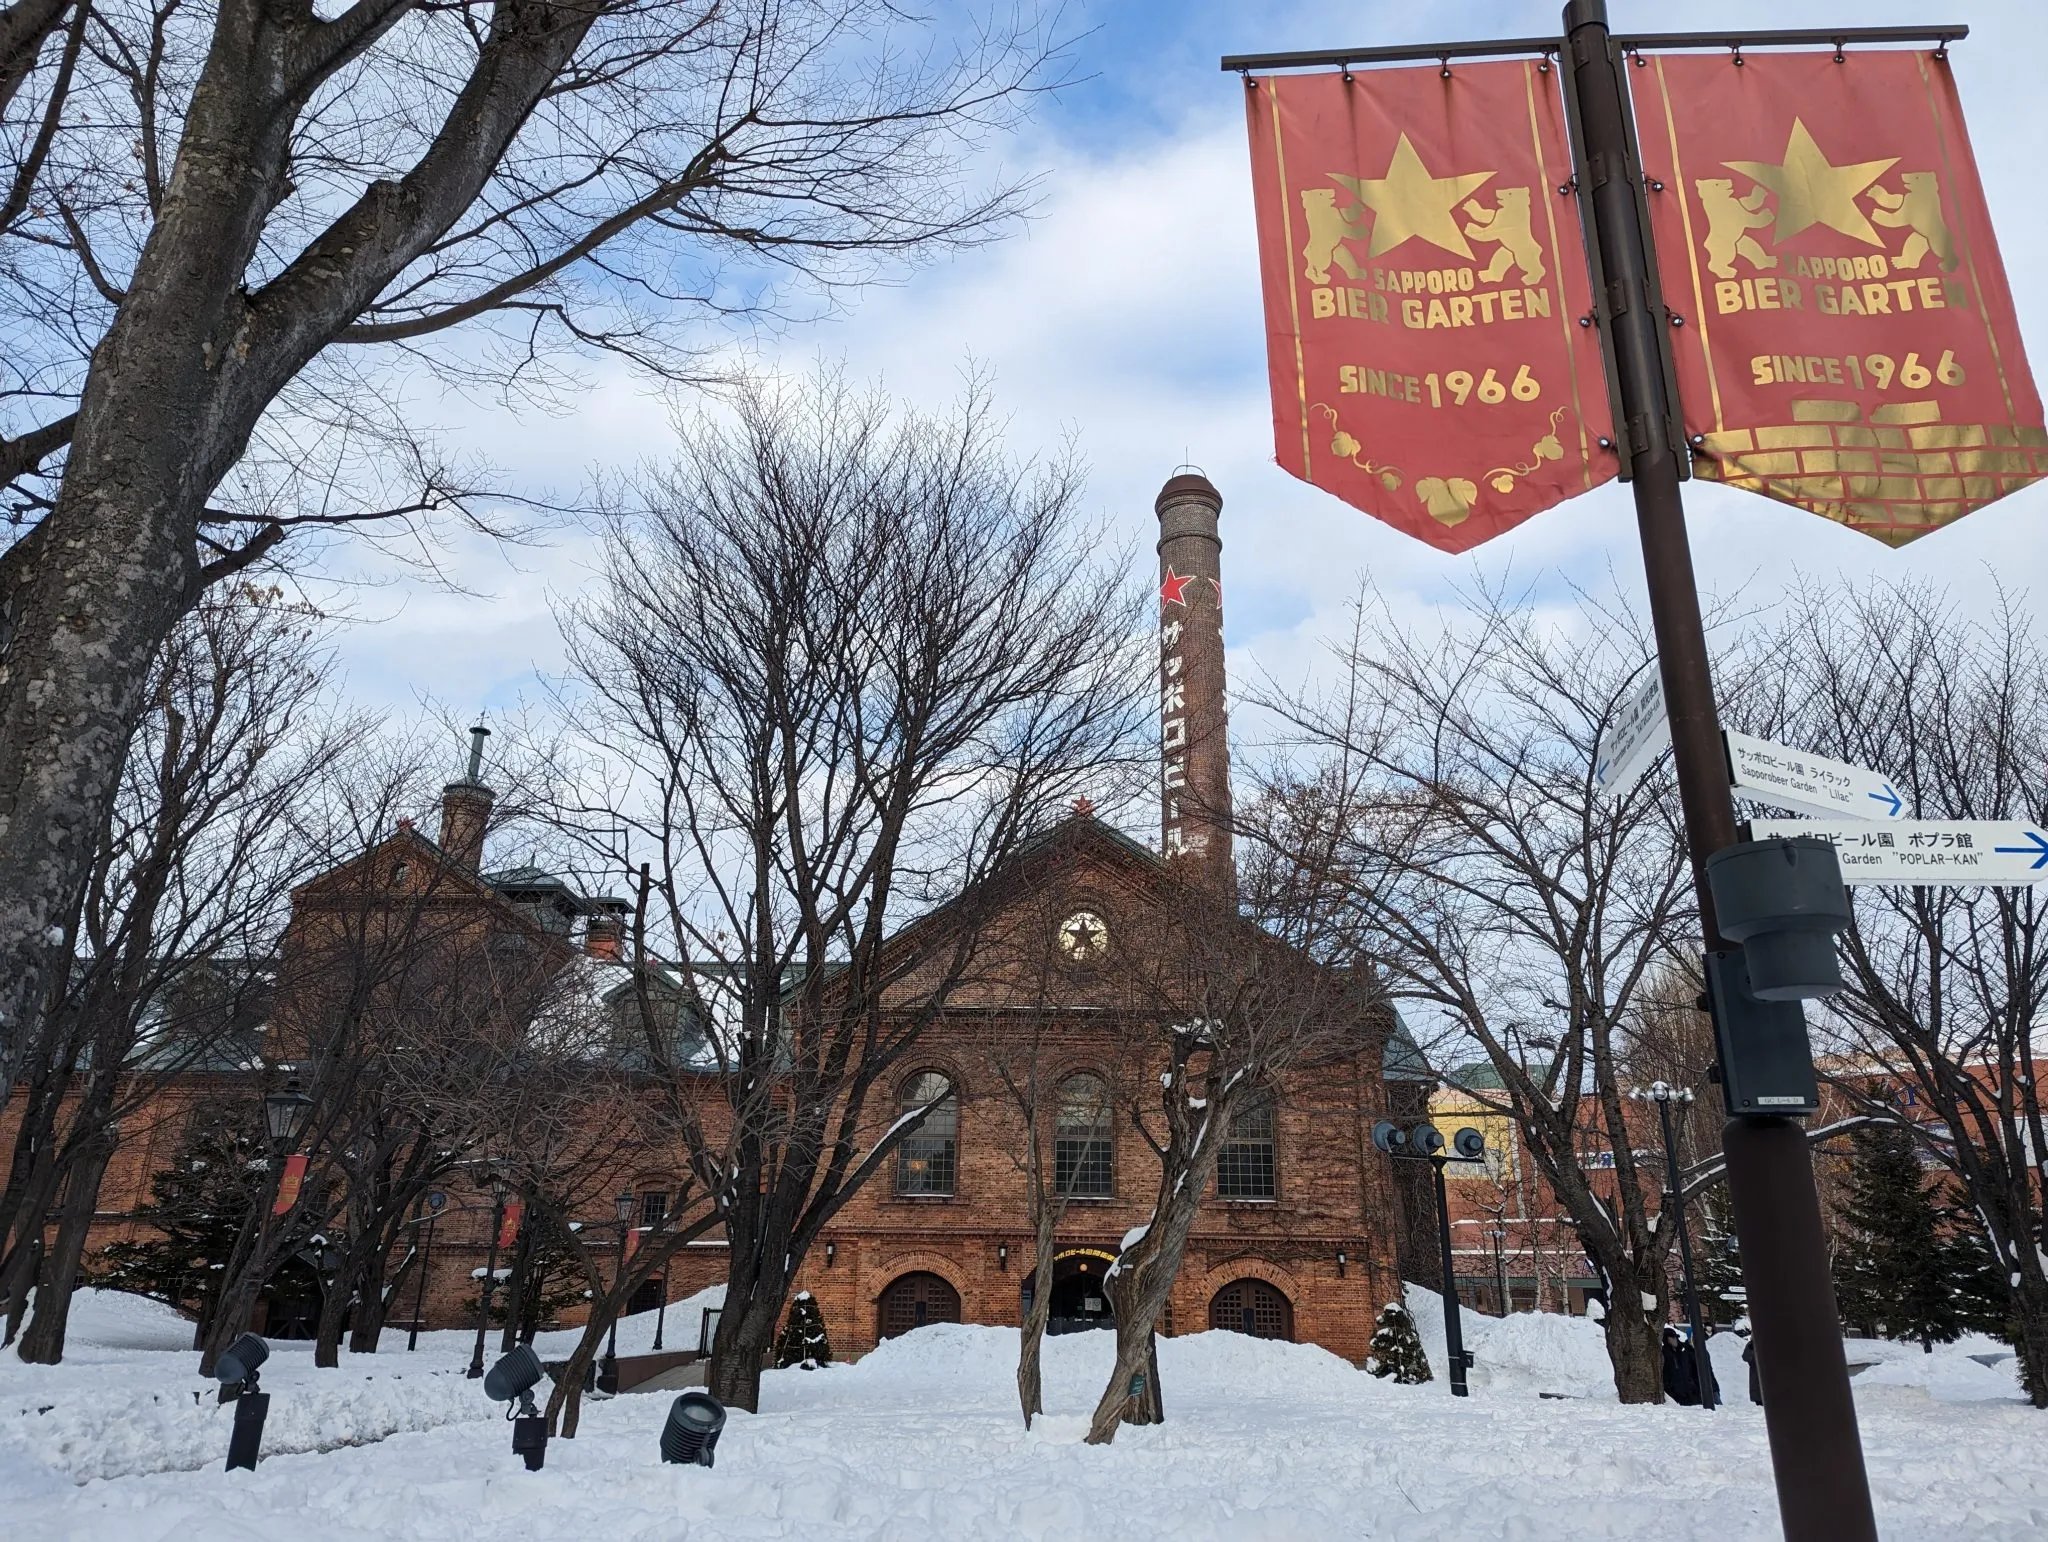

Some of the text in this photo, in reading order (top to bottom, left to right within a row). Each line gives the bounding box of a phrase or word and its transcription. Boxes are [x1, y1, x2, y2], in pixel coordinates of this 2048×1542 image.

[1373, 267, 1474, 294] SAPPORO
[1715, 277, 1969, 316] BIER GARTEN
[1311, 287, 1551, 329] BIER GARTEN
[1339, 364, 1540, 408] SINCE 1966
[1750, 349, 1966, 390] SINCE 1966
[1737, 747, 1851, 788] サッポロビール園 ライラック
[1741, 764, 1788, 786] Sapporobeer
[1790, 777, 1818, 794] Garden
[1842, 853, 1883, 865] Garden
[1908, 831, 1973, 848] ポプラ館
